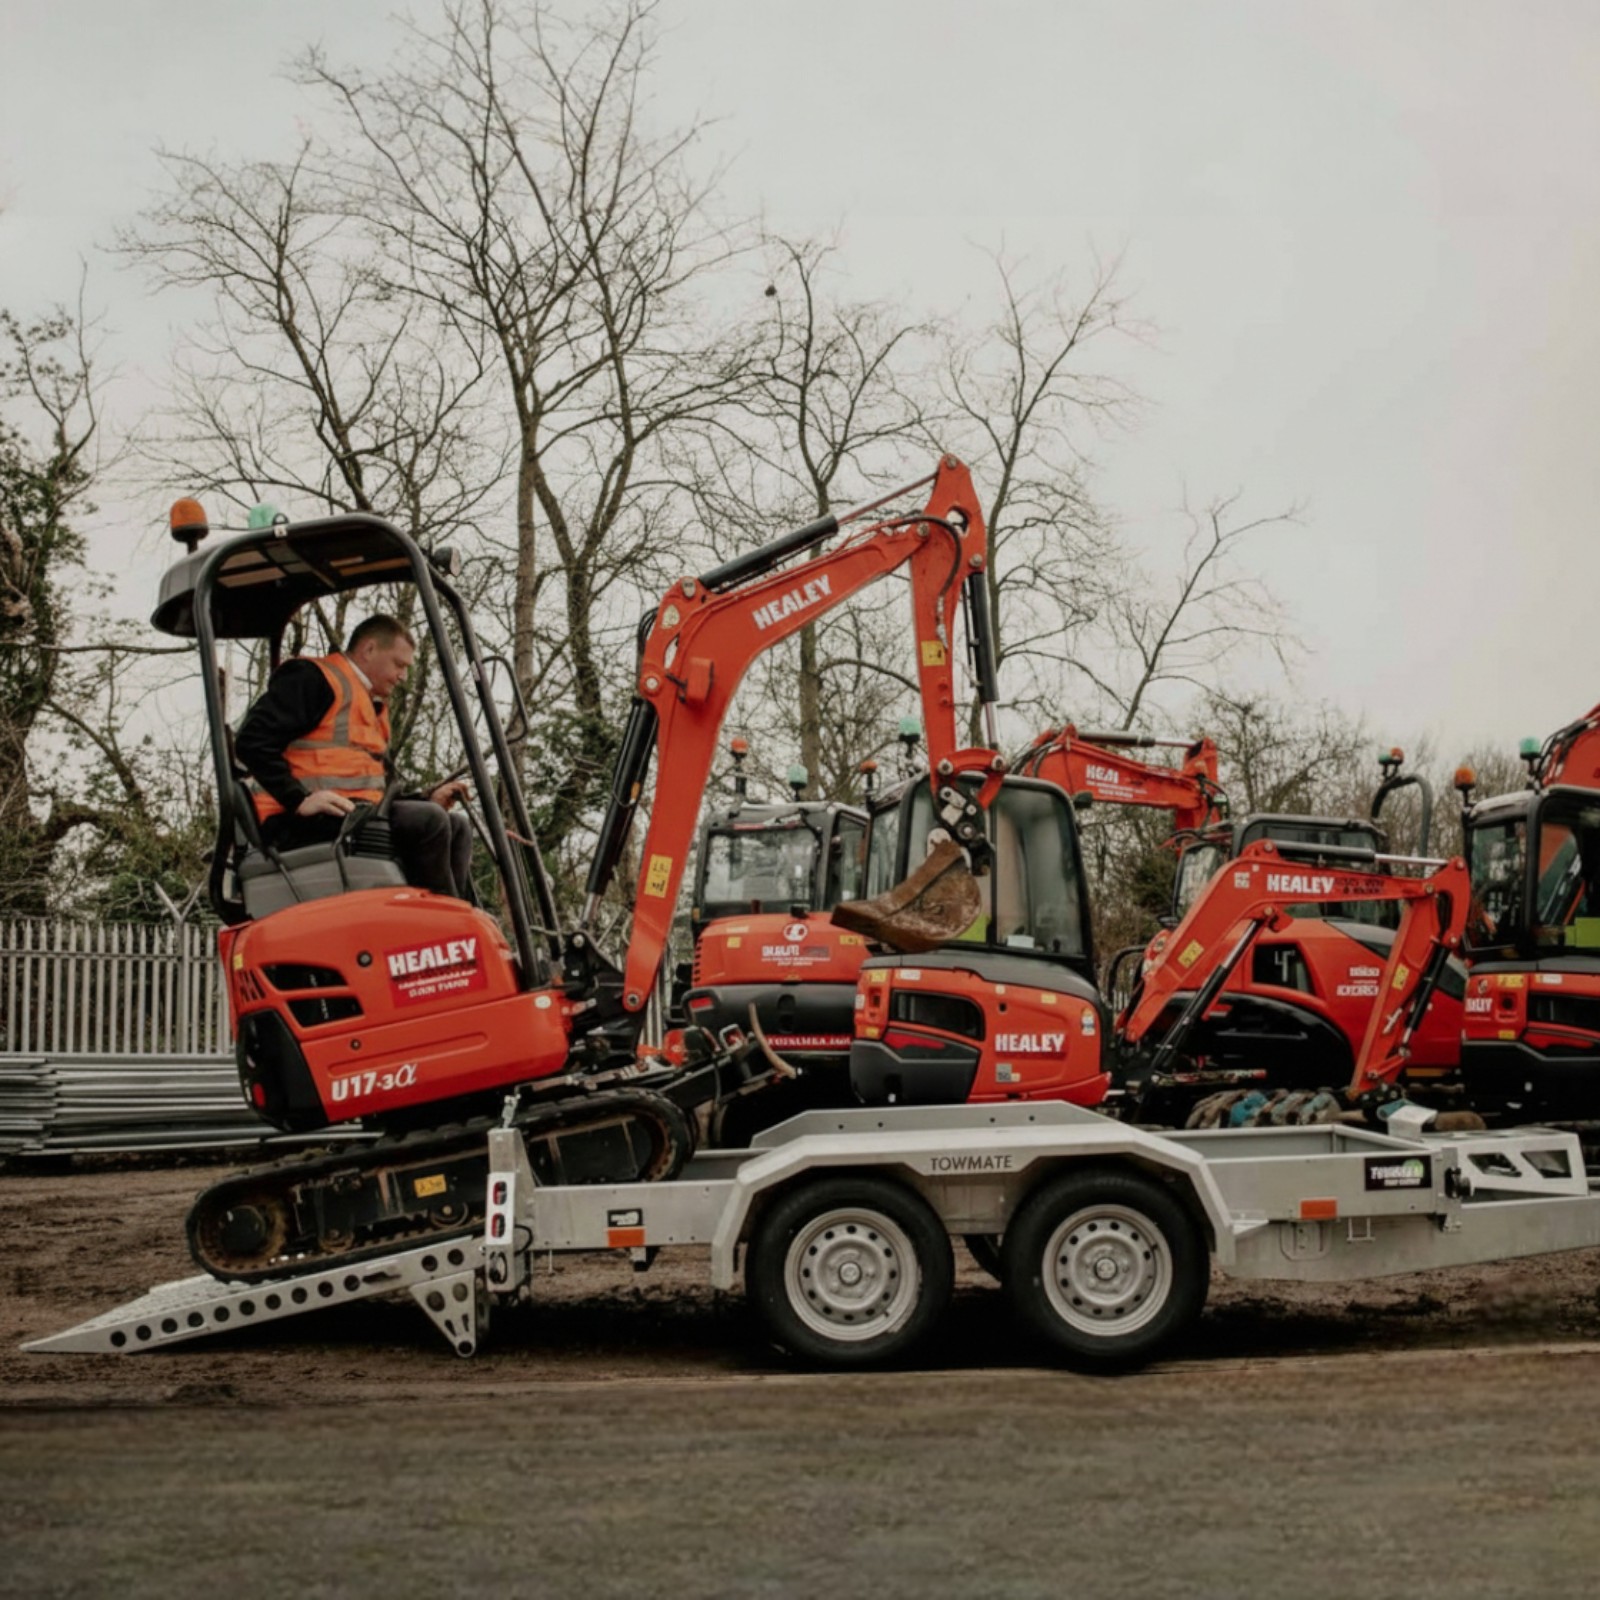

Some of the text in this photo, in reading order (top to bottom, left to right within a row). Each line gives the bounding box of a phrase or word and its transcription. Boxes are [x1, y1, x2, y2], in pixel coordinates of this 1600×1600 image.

[752, 574, 832, 631] HEALEY
[1266, 874, 1334, 894] HEALEY
[387, 938, 476, 977] HEALEY
[995, 1033, 1065, 1053] HEALEY
[930, 1154, 1012, 1171] TOWMATE
